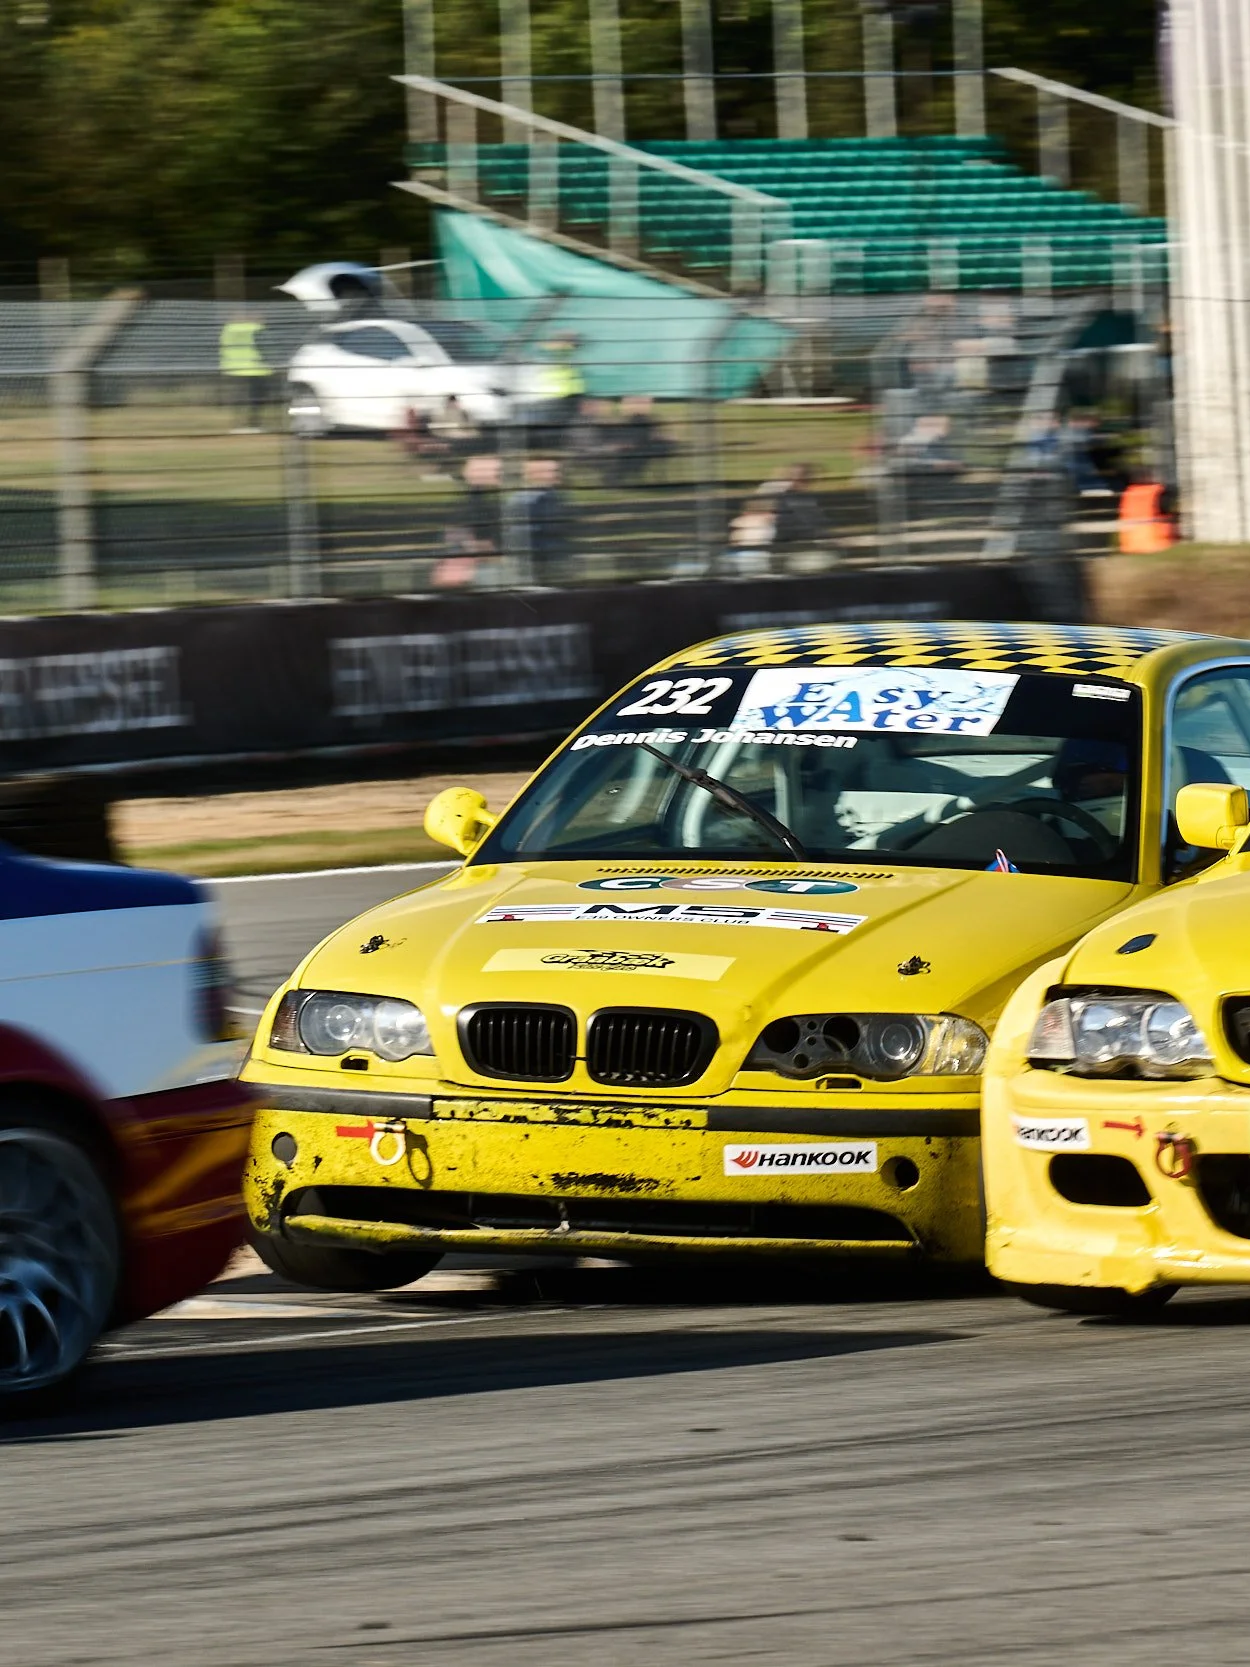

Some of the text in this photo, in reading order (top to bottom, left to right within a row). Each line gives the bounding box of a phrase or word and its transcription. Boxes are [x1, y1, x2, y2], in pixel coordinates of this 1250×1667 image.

[616, 677, 733, 717] 232
[570, 728, 859, 750] Dennis Johansen
[597, 877, 840, 893] CST
[584, 904, 766, 918] M5
[701, 917, 750, 925] CLUB
